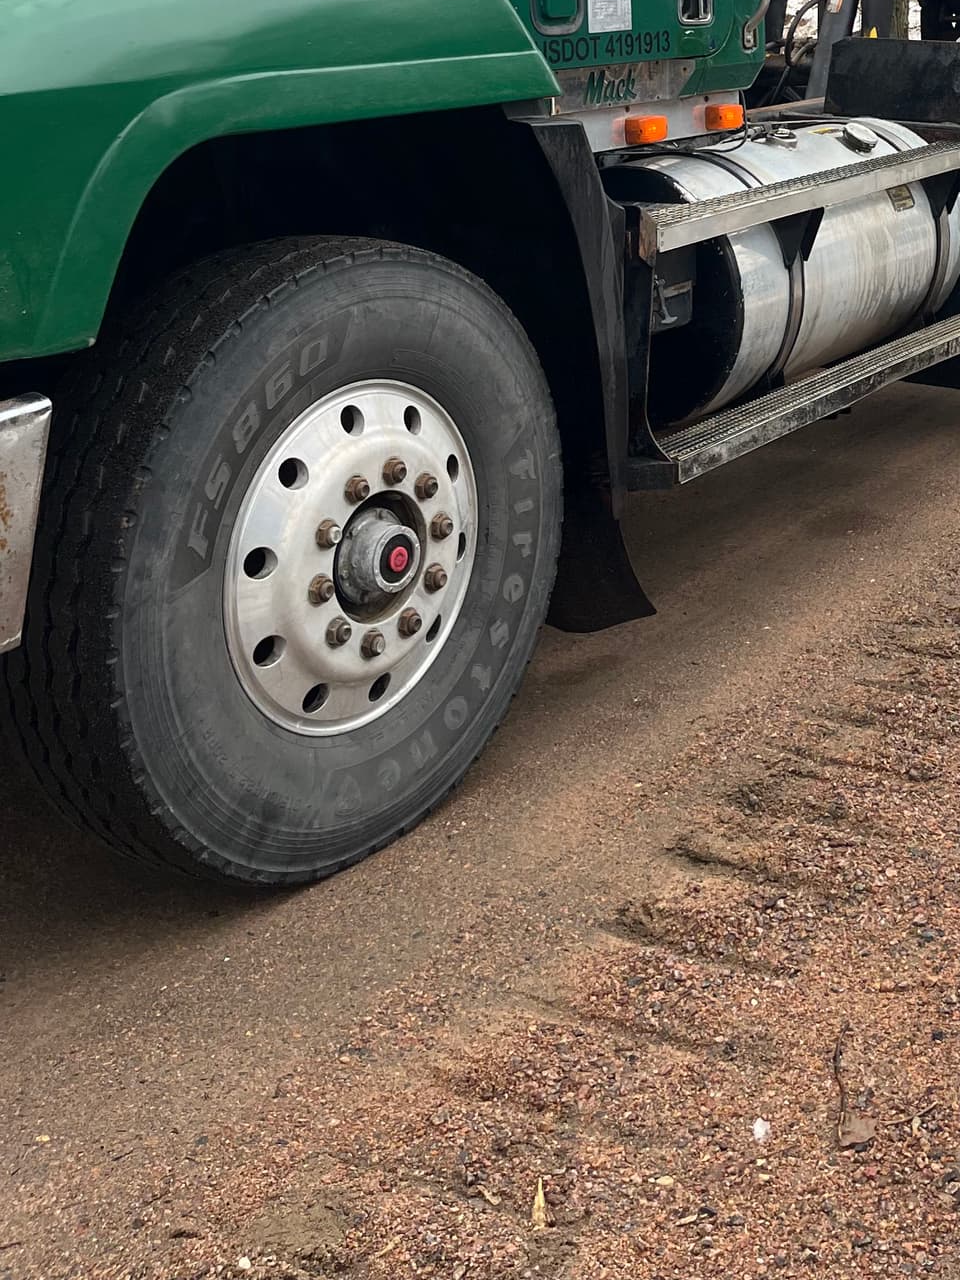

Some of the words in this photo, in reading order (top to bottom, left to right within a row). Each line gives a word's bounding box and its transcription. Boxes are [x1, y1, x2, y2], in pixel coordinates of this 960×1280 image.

[605, 30, 671, 57] 4191913
[585, 69, 637, 105] Mack
[376, 448, 537, 792] Firestone
